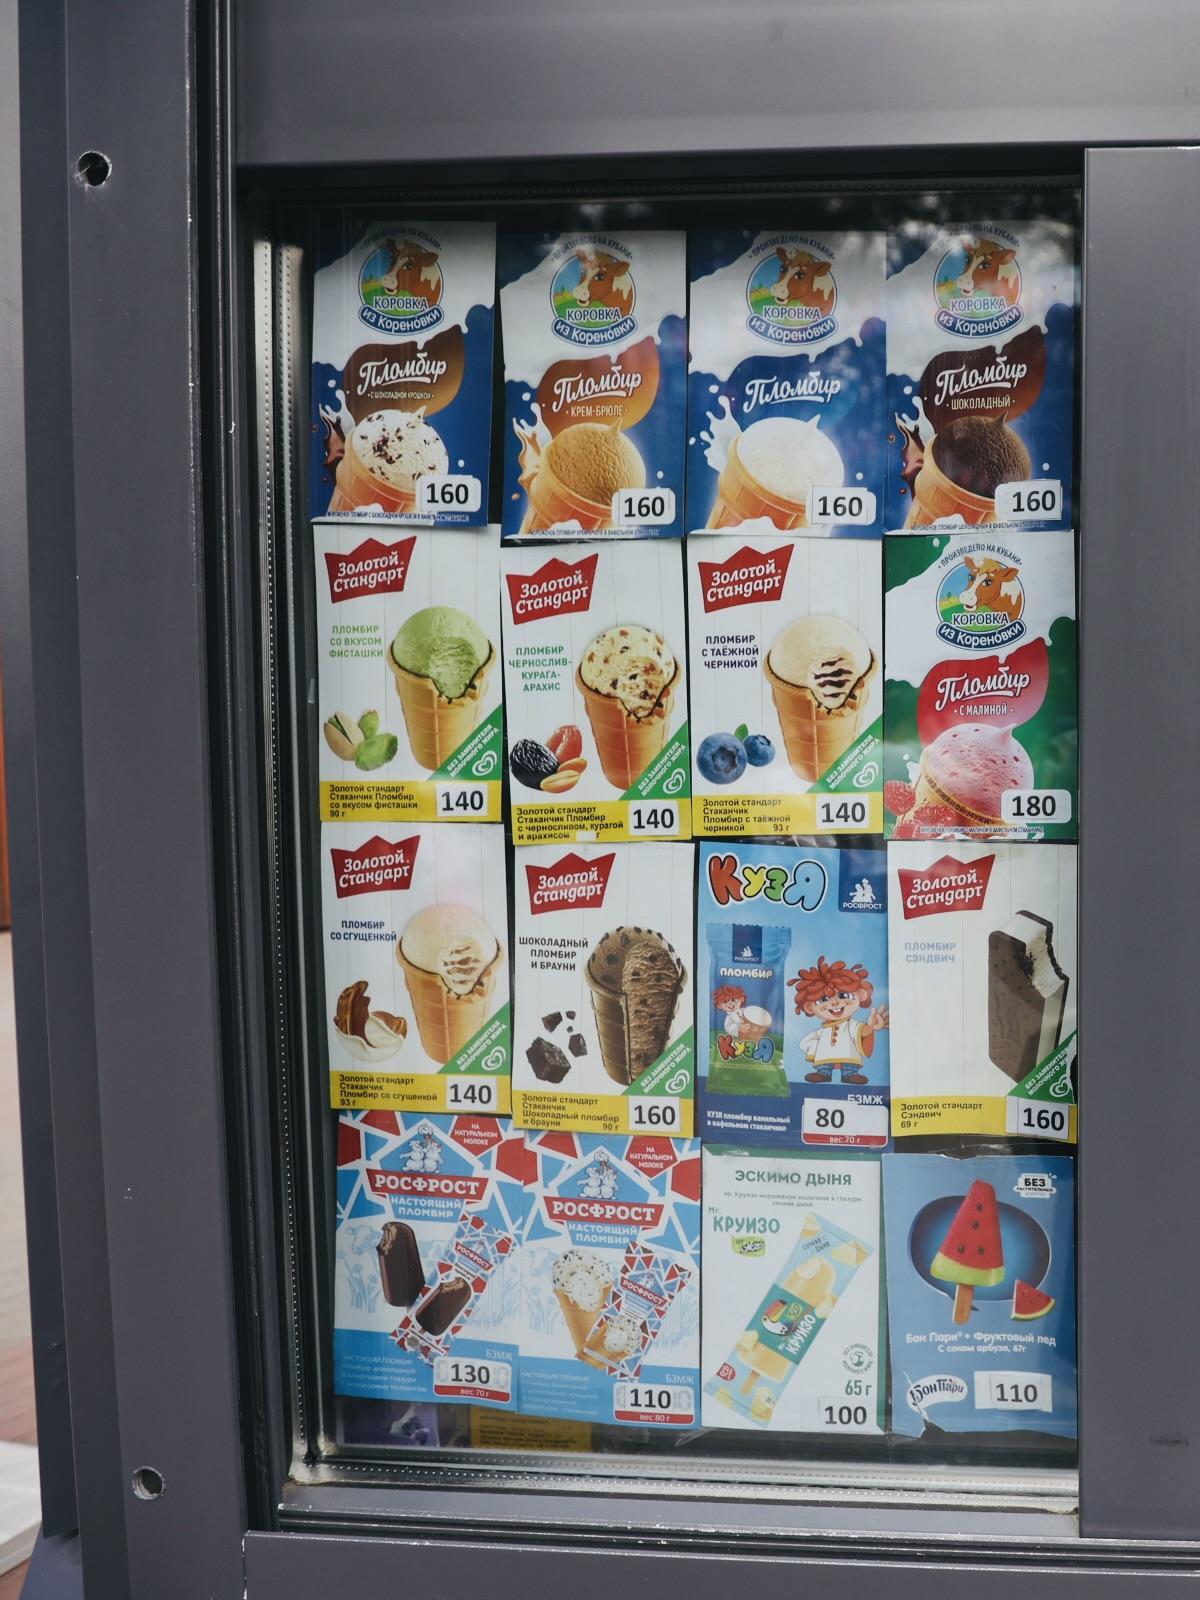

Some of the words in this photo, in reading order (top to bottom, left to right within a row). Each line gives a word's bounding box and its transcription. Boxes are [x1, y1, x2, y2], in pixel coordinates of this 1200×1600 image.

[374, 297, 428, 310] КОРОВКА
[951, 297, 1006, 312] КОРОВКА
[567, 308, 621, 321] КОРОВКА
[763, 306, 821, 319] КОРОВКА
[357, 352, 447, 395] Пломбир
[934, 356, 1028, 406] Пломбир
[552, 365, 641, 413] Пломбир
[743, 371, 841, 413] Пломбир
[571, 405, 623, 416] КРЕМ-БРЮЛЕ
[951, 395, 1011, 410] ШОКОЛАДНЫЙ
[426, 483, 469, 504] 160
[1013, 490, 1056, 512] 160
[624, 496, 665, 517] 160
[818, 496, 863, 516] 160
[996, 546, 1021, 564] КУБАНИ
[337, 551, 399, 577] Золотой
[333, 567, 404, 593] Стандарт
[711, 559, 776, 586] Золотой
[520, 570, 583, 598] Золотой
[707, 575, 781, 602] Стандарт
[515, 586, 589, 614] Стандарт
[953, 613, 1009, 626] КОРОВКА
[332, 625, 379, 635] ПЛОМБИР
[330, 638, 342, 646] СО
[344, 636, 382, 646] ВКУСОМ
[706, 635, 755, 645] ПЛОМБИР
[329, 649, 384, 658] ФИСТАШКИ
[515, 646, 564, 656] ПЛОМБИР
[711, 645, 759, 656] ТАЁЖНОЙ
[508, 657, 572, 668] ЧЕРНОСЛИВ-
[704, 658, 758, 669] ЧЕРНИКОЙ
[521, 671, 561, 680] КУРАГА-
[523, 683, 561, 692] АРАХИС
[935, 666, 1030, 711] Пломбир
[959, 705, 965, 715] С
[966, 703, 1007, 716] МАЛИНОЙ
[441, 791, 484, 811] 140
[1012, 796, 1056, 817] 180
[821, 802, 866, 823] 140
[344, 849, 404, 873] Золотой
[339, 866, 410, 887] Стандарт
[538, 866, 598, 889] Золотой
[912, 869, 977, 893] Золотой
[533, 883, 603, 905] Стандарт
[907, 886, 983, 909] Стандарт
[341, 920, 385, 929] ПЛОМБИР
[330, 932, 341, 940] СО
[343, 931, 397, 942] СГУЩЕНКОЙ
[519, 937, 589, 948] ШОКОЛАДНЫЙ
[530, 949, 577, 959] ПЛОМБИР
[904, 942, 956, 951] ПЛОМБИР
[531, 961, 538, 969] И
[540, 961, 576, 971] БРАУНИ
[906, 954, 955, 964] СЭНДВИЧ
[449, 1083, 492, 1105] 140
[522, 1093, 557, 1102] Золотой
[559, 1095, 598, 1107] стандарт
[848, 1094, 883, 1105] БЗМЖ
[522, 1102, 566, 1111] Стаканчик
[634, 1105, 676, 1125] 160
[816, 1108, 844, 1128] 80
[901, 1111, 942, 1120] Сэндвич
[1023, 1107, 1065, 1131] 160
[630, 1153, 673, 1161] НАТУРАЛЬНОМ
[375, 1175, 479, 1195] РОСФРОСТ
[735, 1170, 801, 1184] ЭСКИМО
[805, 1172, 852, 1187] ДЫНЯ
[1024, 1177, 1046, 1187] БЕЗ
[391, 1196, 462, 1209] НАСТОЯЩИЙ
[399, 1208, 454, 1218] ПЛОМБИР
[553, 1201, 655, 1221] РОСФРОСТ
[568, 1223, 638, 1236] НАСТОЯЩИЙ
[713, 1215, 780, 1234] КРУИЗО
[576, 1233, 630, 1244] ПЛОМБИР
[974, 1332, 1034, 1345] Фруктовый
[1037, 1335, 1057, 1347] лед
[486, 1350, 513, 1361] БЗМЖ
[451, 1363, 490, 1384] 130
[665, 1374, 695, 1384] БЗМЖ
[845, 1379, 862, 1395] 65
[866, 1384, 872, 1395] г
[936, 1377, 964, 1394] Пари
[996, 1384, 1038, 1403] 110
[630, 1388, 672, 1409] 110
[824, 1406, 867, 1424] 100
